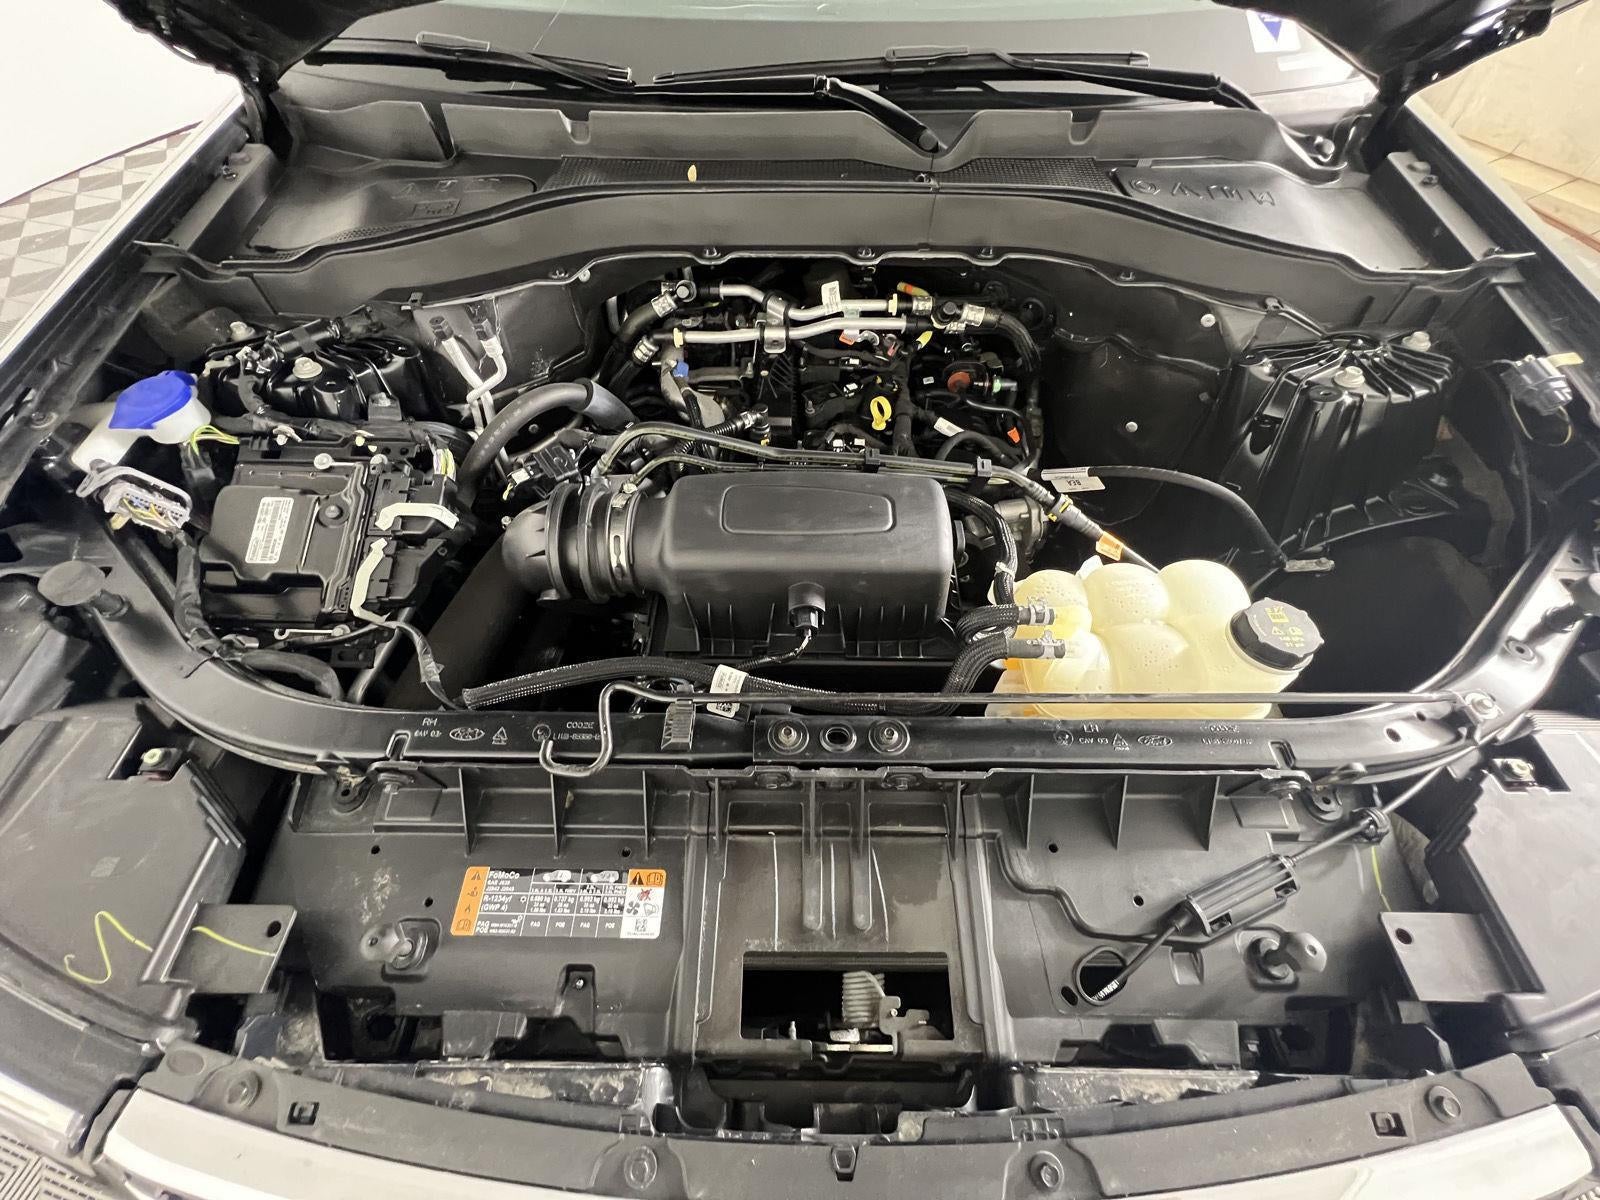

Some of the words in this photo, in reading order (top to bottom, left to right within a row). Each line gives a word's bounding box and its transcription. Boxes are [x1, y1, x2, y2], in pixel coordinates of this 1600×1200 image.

[422, 717, 438, 726] RH
[488, 870, 520, 880] FoMoCo
[483, 894, 513, 904] R-1234yf
[481, 903, 500, 911] (GWP
